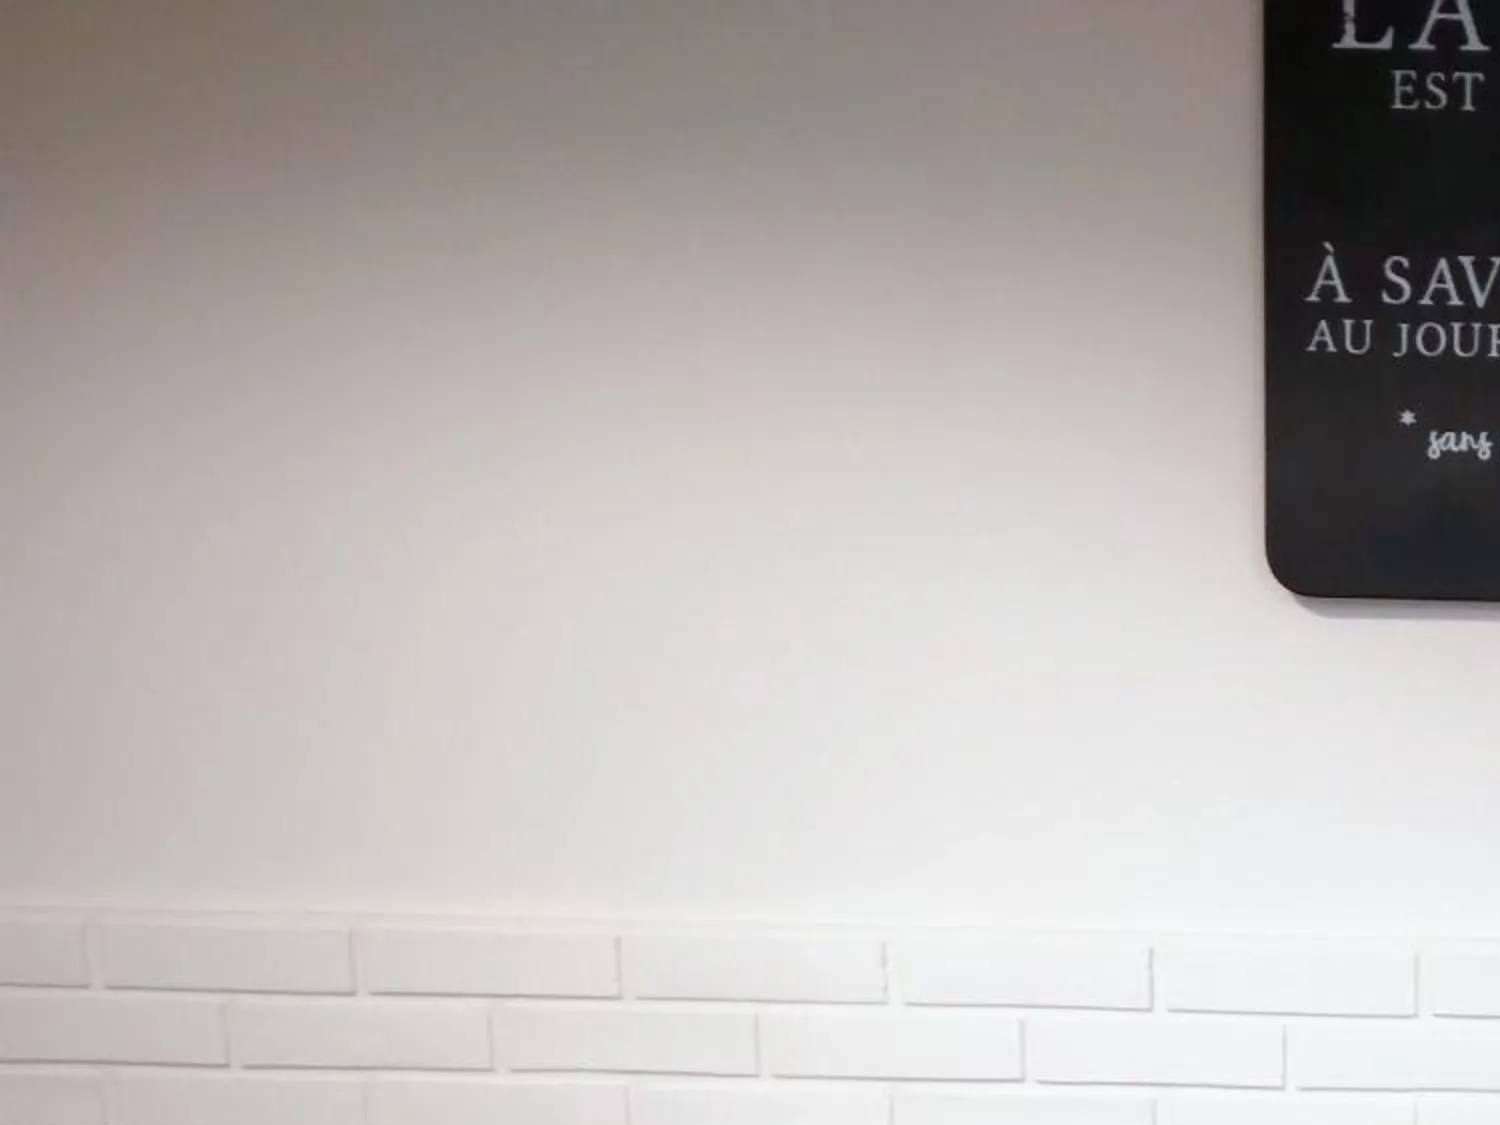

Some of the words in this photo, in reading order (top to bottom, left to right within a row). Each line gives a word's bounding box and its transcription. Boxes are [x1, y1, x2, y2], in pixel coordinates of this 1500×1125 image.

[1392, 69, 1484, 111] EST
[1305, 241, 1352, 304] À
[1306, 318, 1374, 355] AU
[1426, 429, 1494, 462] sans
